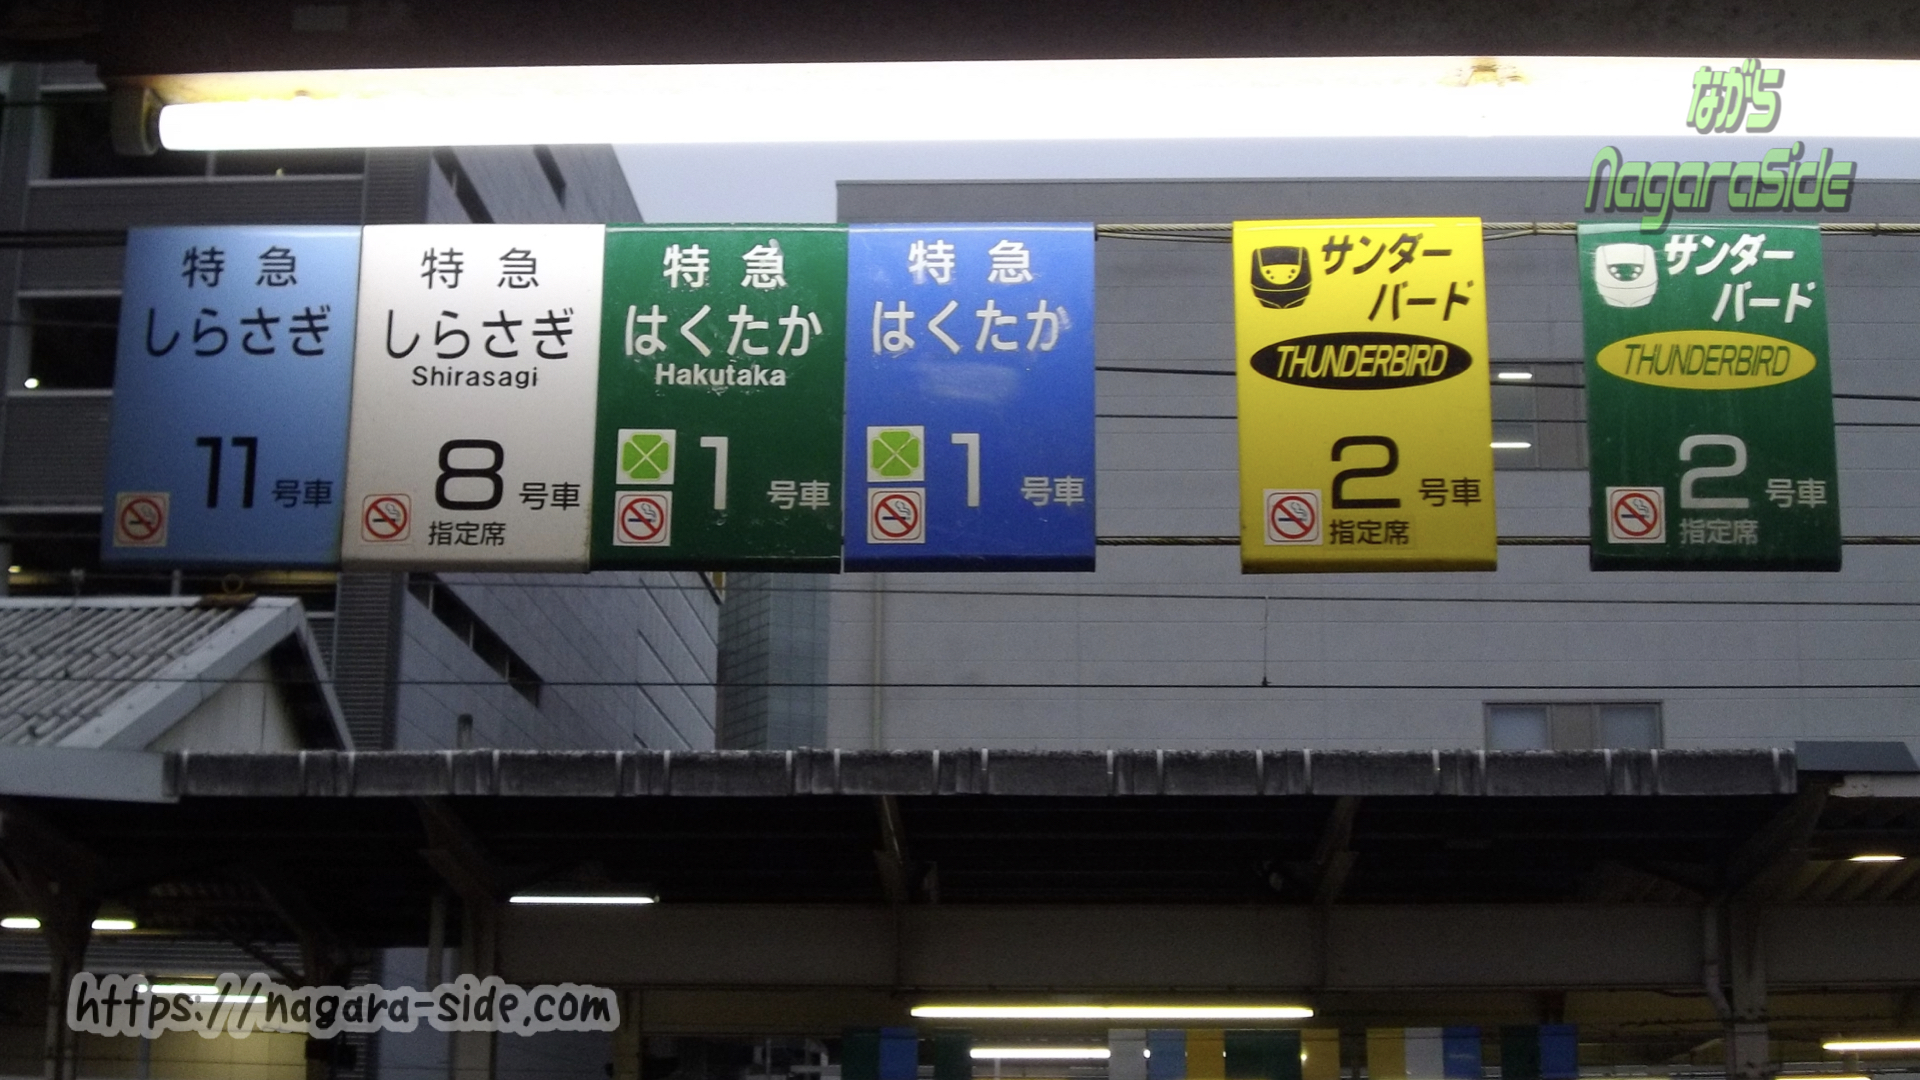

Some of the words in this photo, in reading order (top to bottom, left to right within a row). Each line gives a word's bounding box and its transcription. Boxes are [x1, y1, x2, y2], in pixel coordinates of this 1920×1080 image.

[182, 246, 298, 289] 特急
[420, 247, 540, 290] 特急
[662, 243, 787, 290] 特急
[908, 239, 1034, 285] 特急
[1321, 233, 1453, 274] サンダー
[1664, 233, 1796, 276] サンダー
[1368, 280, 1475, 322] バード
[1711, 281, 1815, 324] バード
[144, 305, 331, 358] しらさぎ
[385, 307, 575, 360] しらさぎ
[624, 304, 823, 358] はくたか
[872, 299, 1072, 355] はくたか
[411, 365, 539, 389] Shirasagi
[655, 363, 787, 387] Hakutaka
[1276, 344, 1448, 378] THUNDERBIRD
[1624, 342, 1791, 377] THUNDERBIRD
[196, 436, 258, 510] 11
[272, 478, 333, 509] 号車
[434, 438, 505, 511] 8
[518, 480, 582, 511] 号車
[700, 436, 729, 510] 1
[766, 479, 831, 511] 号車
[951, 432, 981, 508] 1
[1020, 475, 1086, 508] 号車
[1330, 435, 1401, 510] 2
[1418, 477, 1482, 508] 号車
[1678, 434, 1748, 510] 2
[1764, 477, 1828, 509] 号車
[427, 520, 507, 547] 指定席
[1329, 518, 1411, 547] 指定席
[1679, 517, 1759, 546] 指定席
